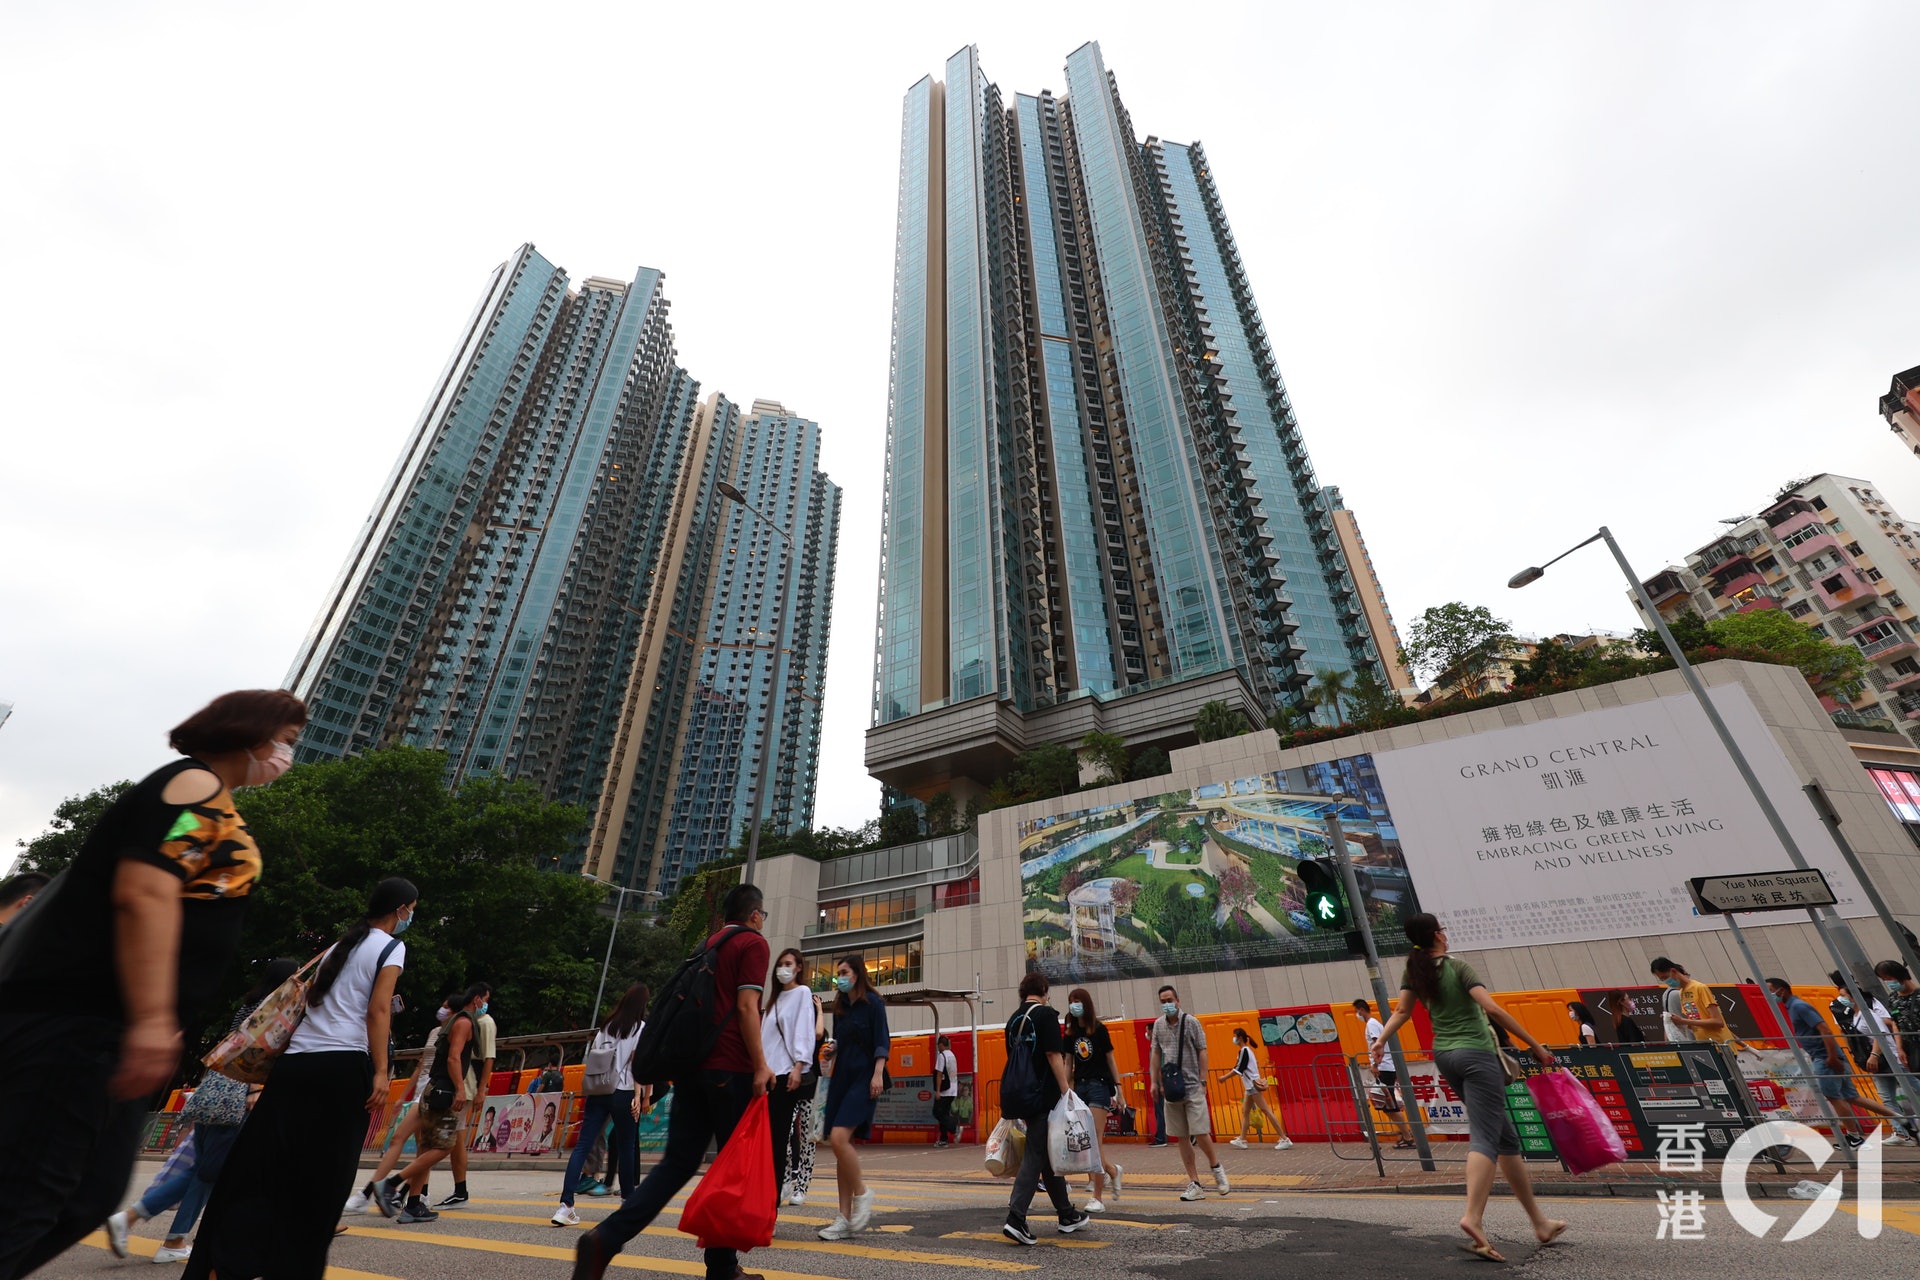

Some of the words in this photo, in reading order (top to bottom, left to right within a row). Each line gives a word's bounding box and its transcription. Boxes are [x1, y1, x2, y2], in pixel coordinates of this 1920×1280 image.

[1460, 754, 1539, 779] GRAND
[1549, 734, 1660, 764] CENTRAL
[1481, 798, 1696, 843] 擁抱綠色及健康生活
[1476, 837, 1578, 862] EMBRACING
[1586, 829, 1647, 848] GREEN
[1655, 818, 1724, 839] LIVING
[1533, 856, 1572, 871] AND
[1579, 843, 1674, 866] WELLNESS
[1721, 879, 1745, 890] Yue
[1748, 877, 1774, 888] Man
[1775, 875, 1819, 887] Square
[1751, 890, 1805, 905] 裕民坊
[1640, 994, 1660, 1004] 3&5
